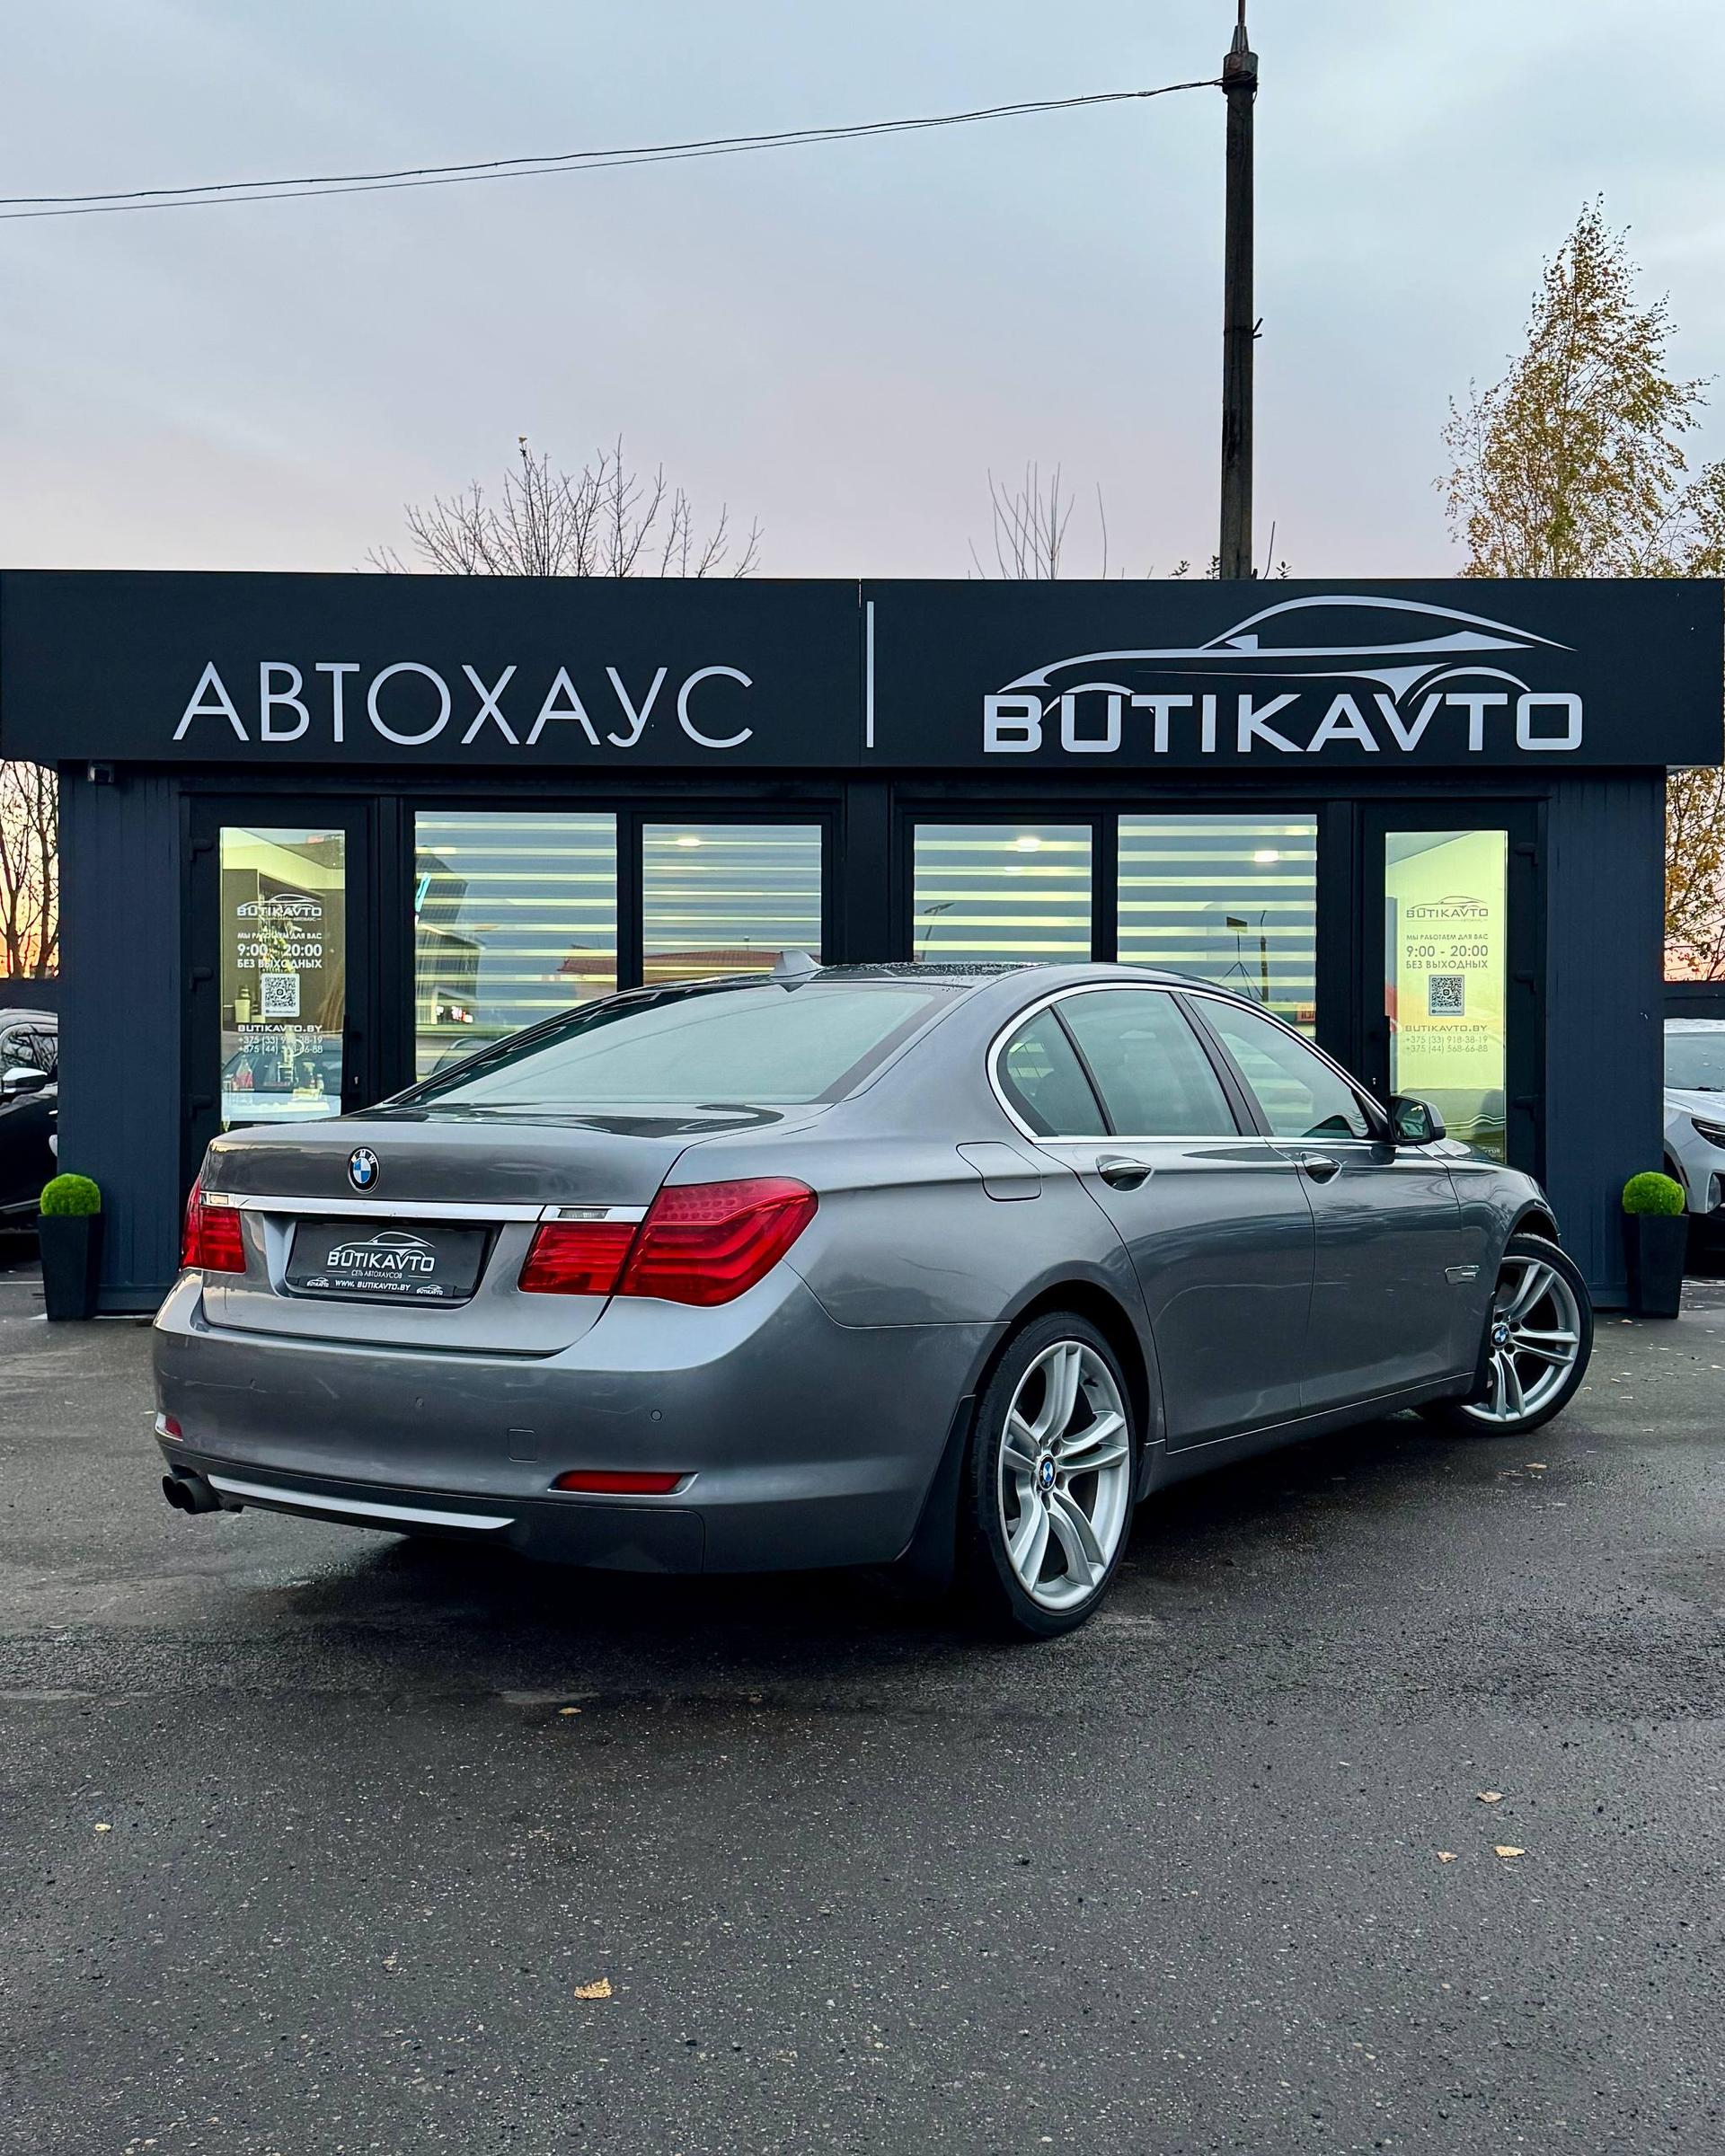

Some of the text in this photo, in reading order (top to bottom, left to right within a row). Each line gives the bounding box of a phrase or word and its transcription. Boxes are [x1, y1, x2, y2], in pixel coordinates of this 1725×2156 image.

[172, 662, 753, 748] АВТОХАУС
[984, 694, 1582, 753] BUTIKAVTO
[237, 906, 322, 916] BUTIKAVTO
[1406, 908, 1488, 917] BUTIKAVTO
[237, 943, 268, 957] 9:00
[281, 943, 322, 957] 20:00
[1406, 945, 1435, 957] 9:00
[1450, 945, 1488, 957] 20:00
[237, 959, 322, 969] БЕЗ ВЫХОДНЫХ
[1406, 960, 1488, 969] БЕЗ ВЫХОДНЫХ
[1406, 1036, 1426, 1044] +375
[1429, 1036, 1444, 1046] (33)
[261, 1045, 279, 1055] (44)
[1406, 1045, 1426, 1053] +375
[1429, 1045, 1444, 1055] (44)
[327, 1250, 435, 1272] BUTIKAVTO
[364, 1270, 402, 1279] АВТОХАУСОВ
[335, 1279, 411, 1291] WWW. BUTIKAVTO.BY
